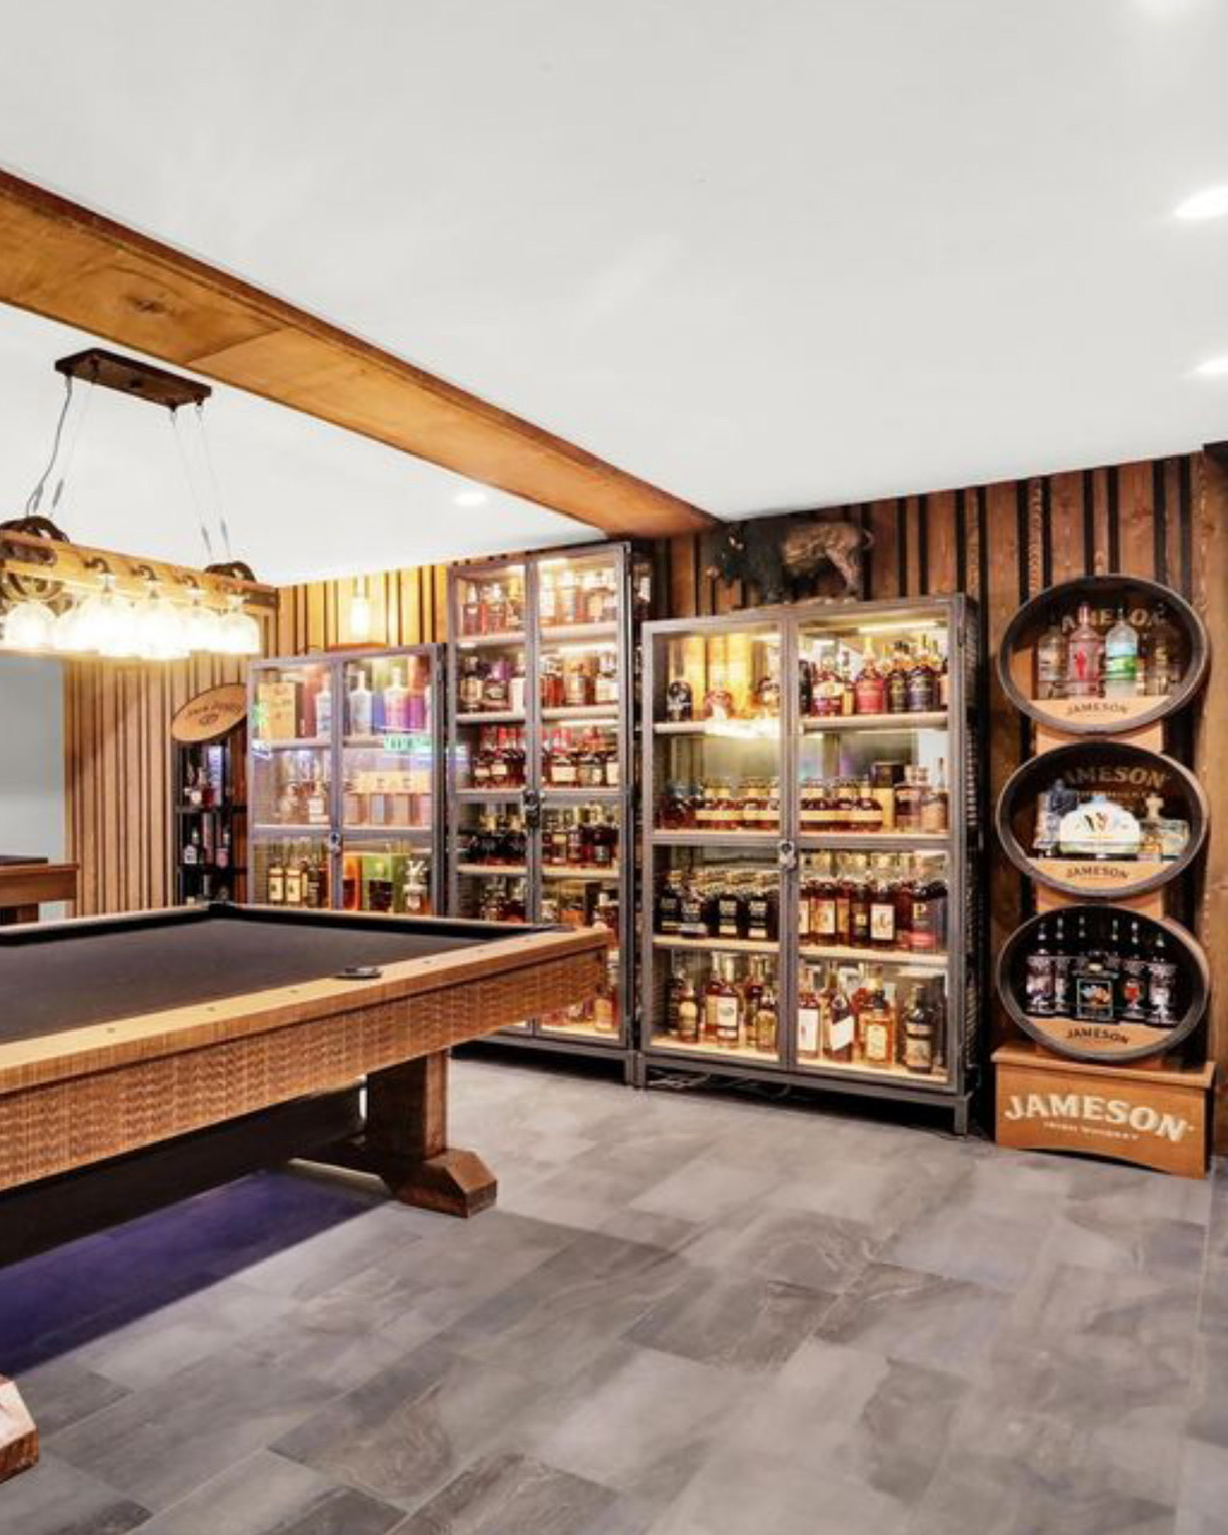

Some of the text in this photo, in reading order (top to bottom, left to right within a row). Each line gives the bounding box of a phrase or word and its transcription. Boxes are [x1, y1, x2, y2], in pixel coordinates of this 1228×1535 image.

[1066, 864, 1130, 880] JAMESON
[1066, 1026, 1130, 1044] JAMESON
[1004, 1092, 1188, 1142] JAMESON
